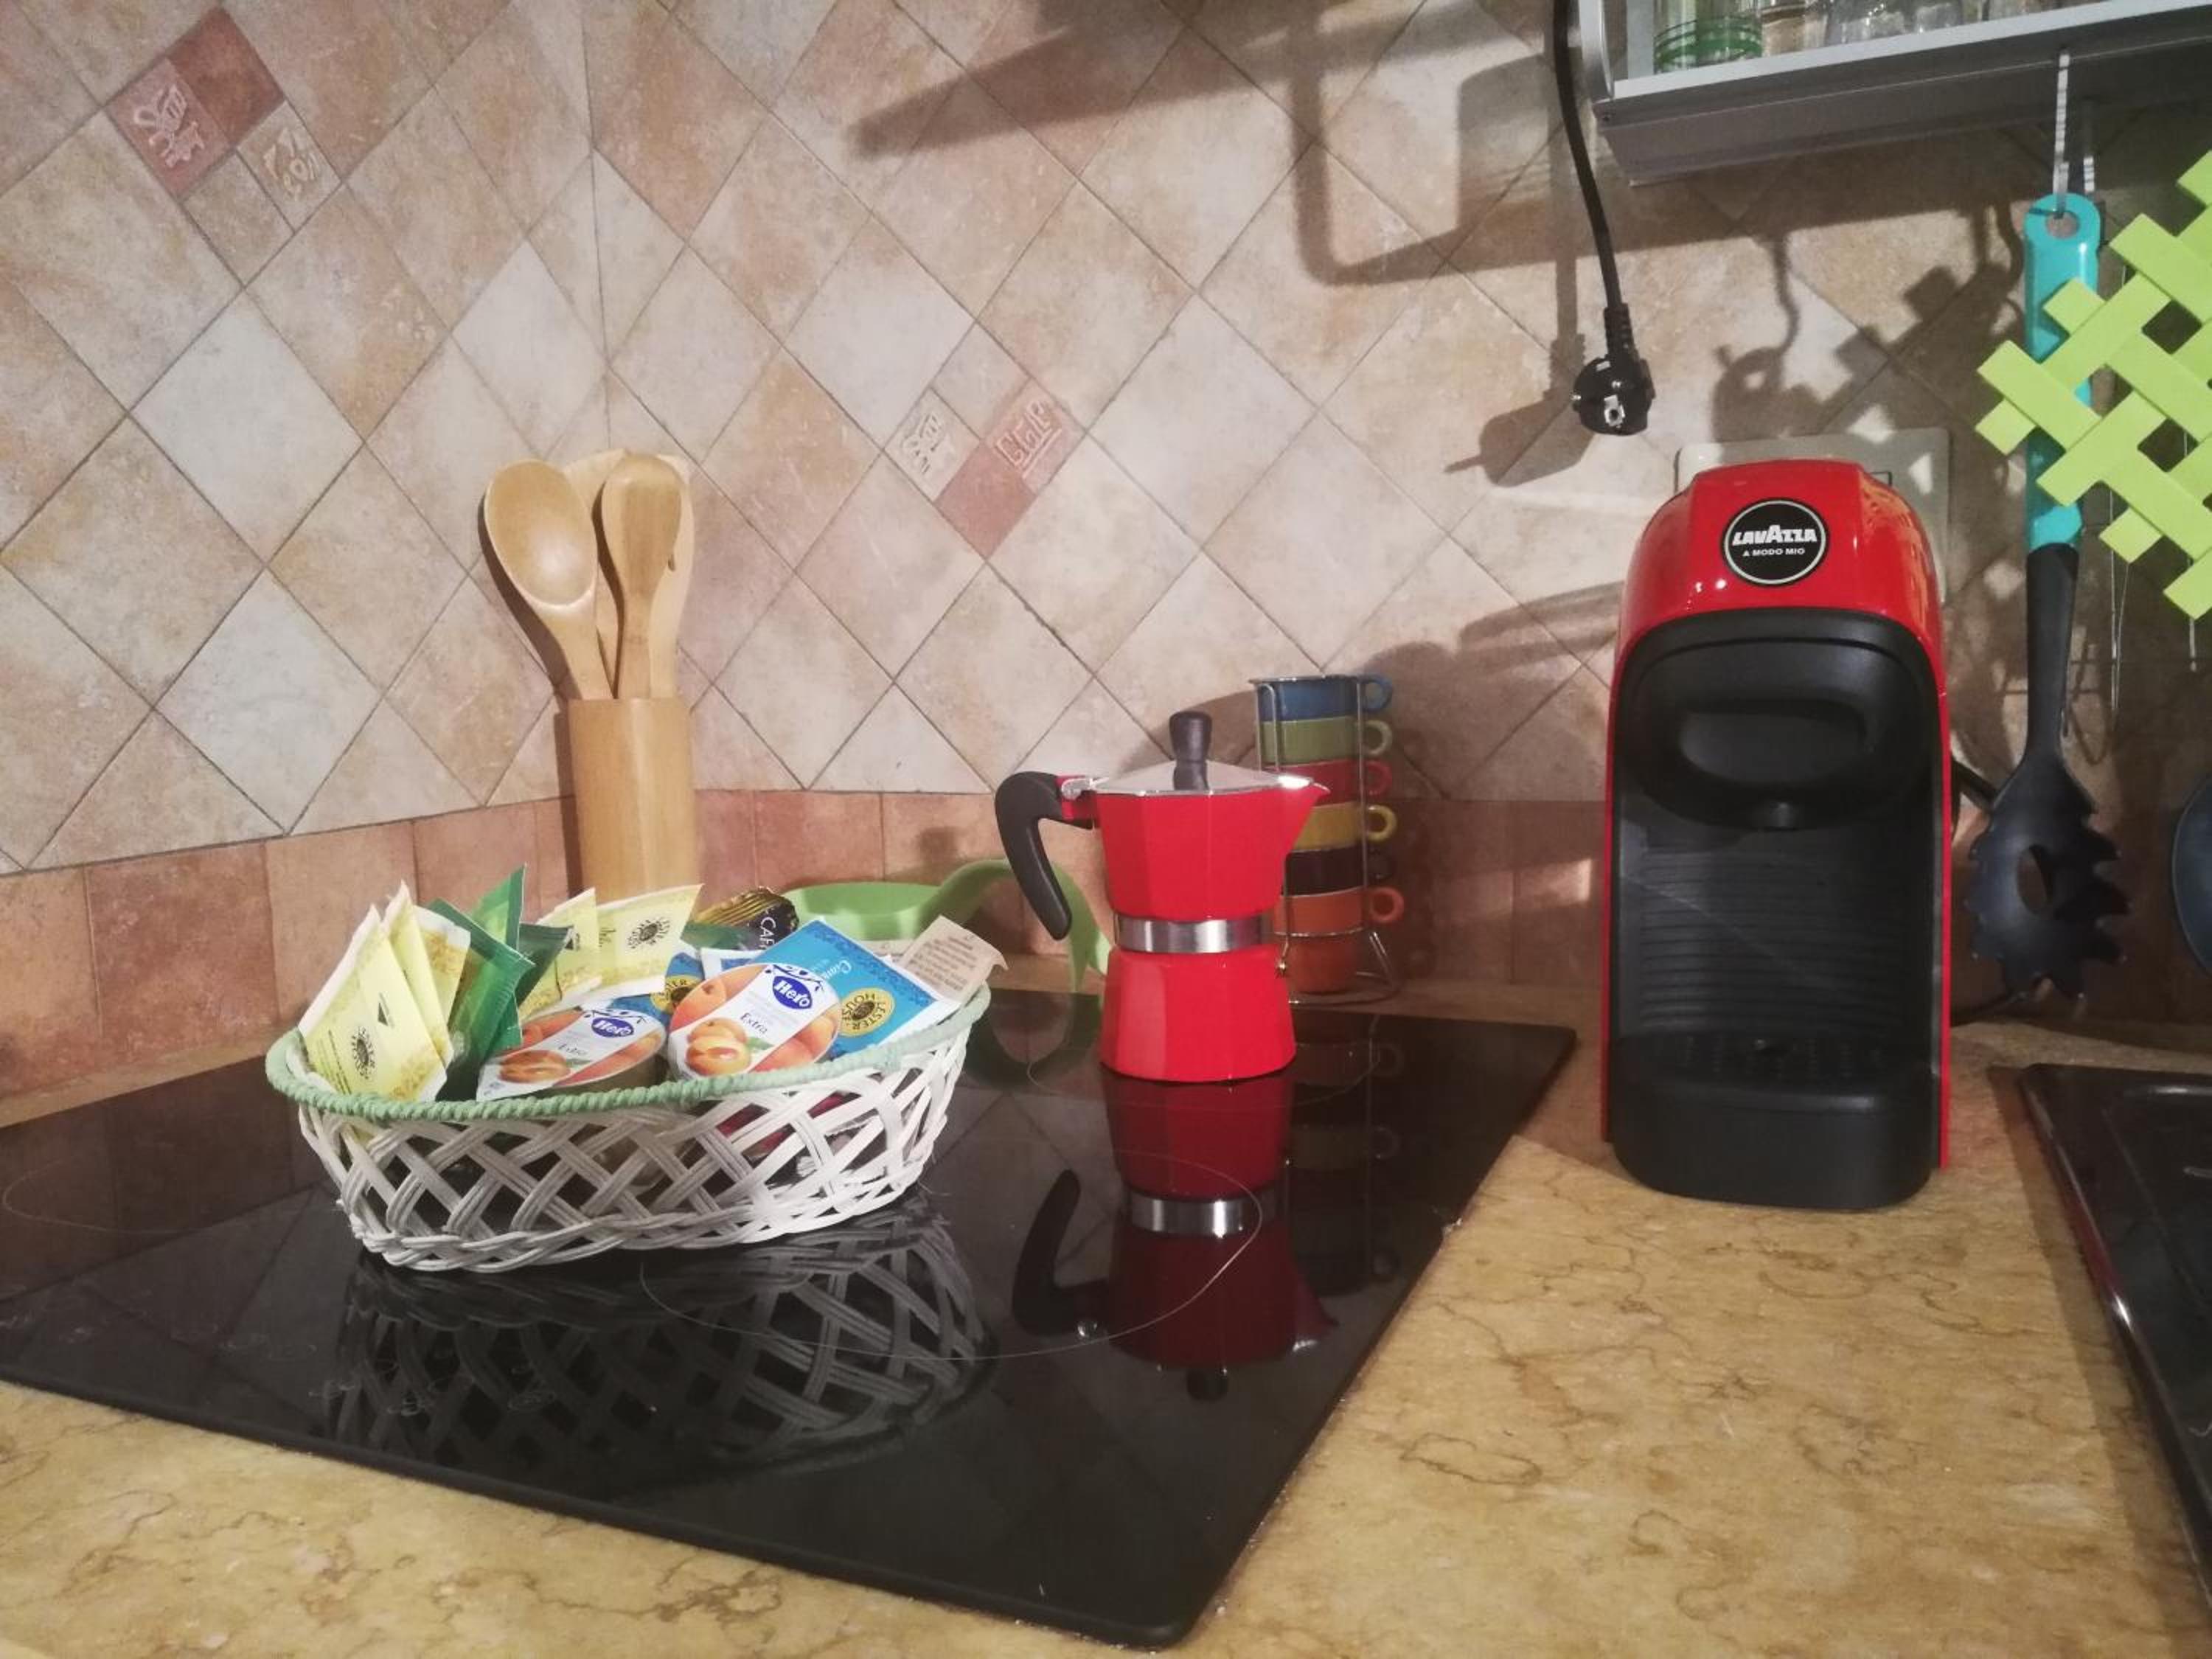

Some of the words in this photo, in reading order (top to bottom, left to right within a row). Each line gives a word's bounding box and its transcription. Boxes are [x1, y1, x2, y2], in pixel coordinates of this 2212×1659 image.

[1732, 524, 1818, 546] LAVAZZA
[1752, 548, 1783, 557] MODO
[1785, 547, 1806, 555] MIO
[773, 980, 811, 1007] Hero
[593, 1020, 632, 1035] Hero
[740, 1012, 768, 1034] Extra
